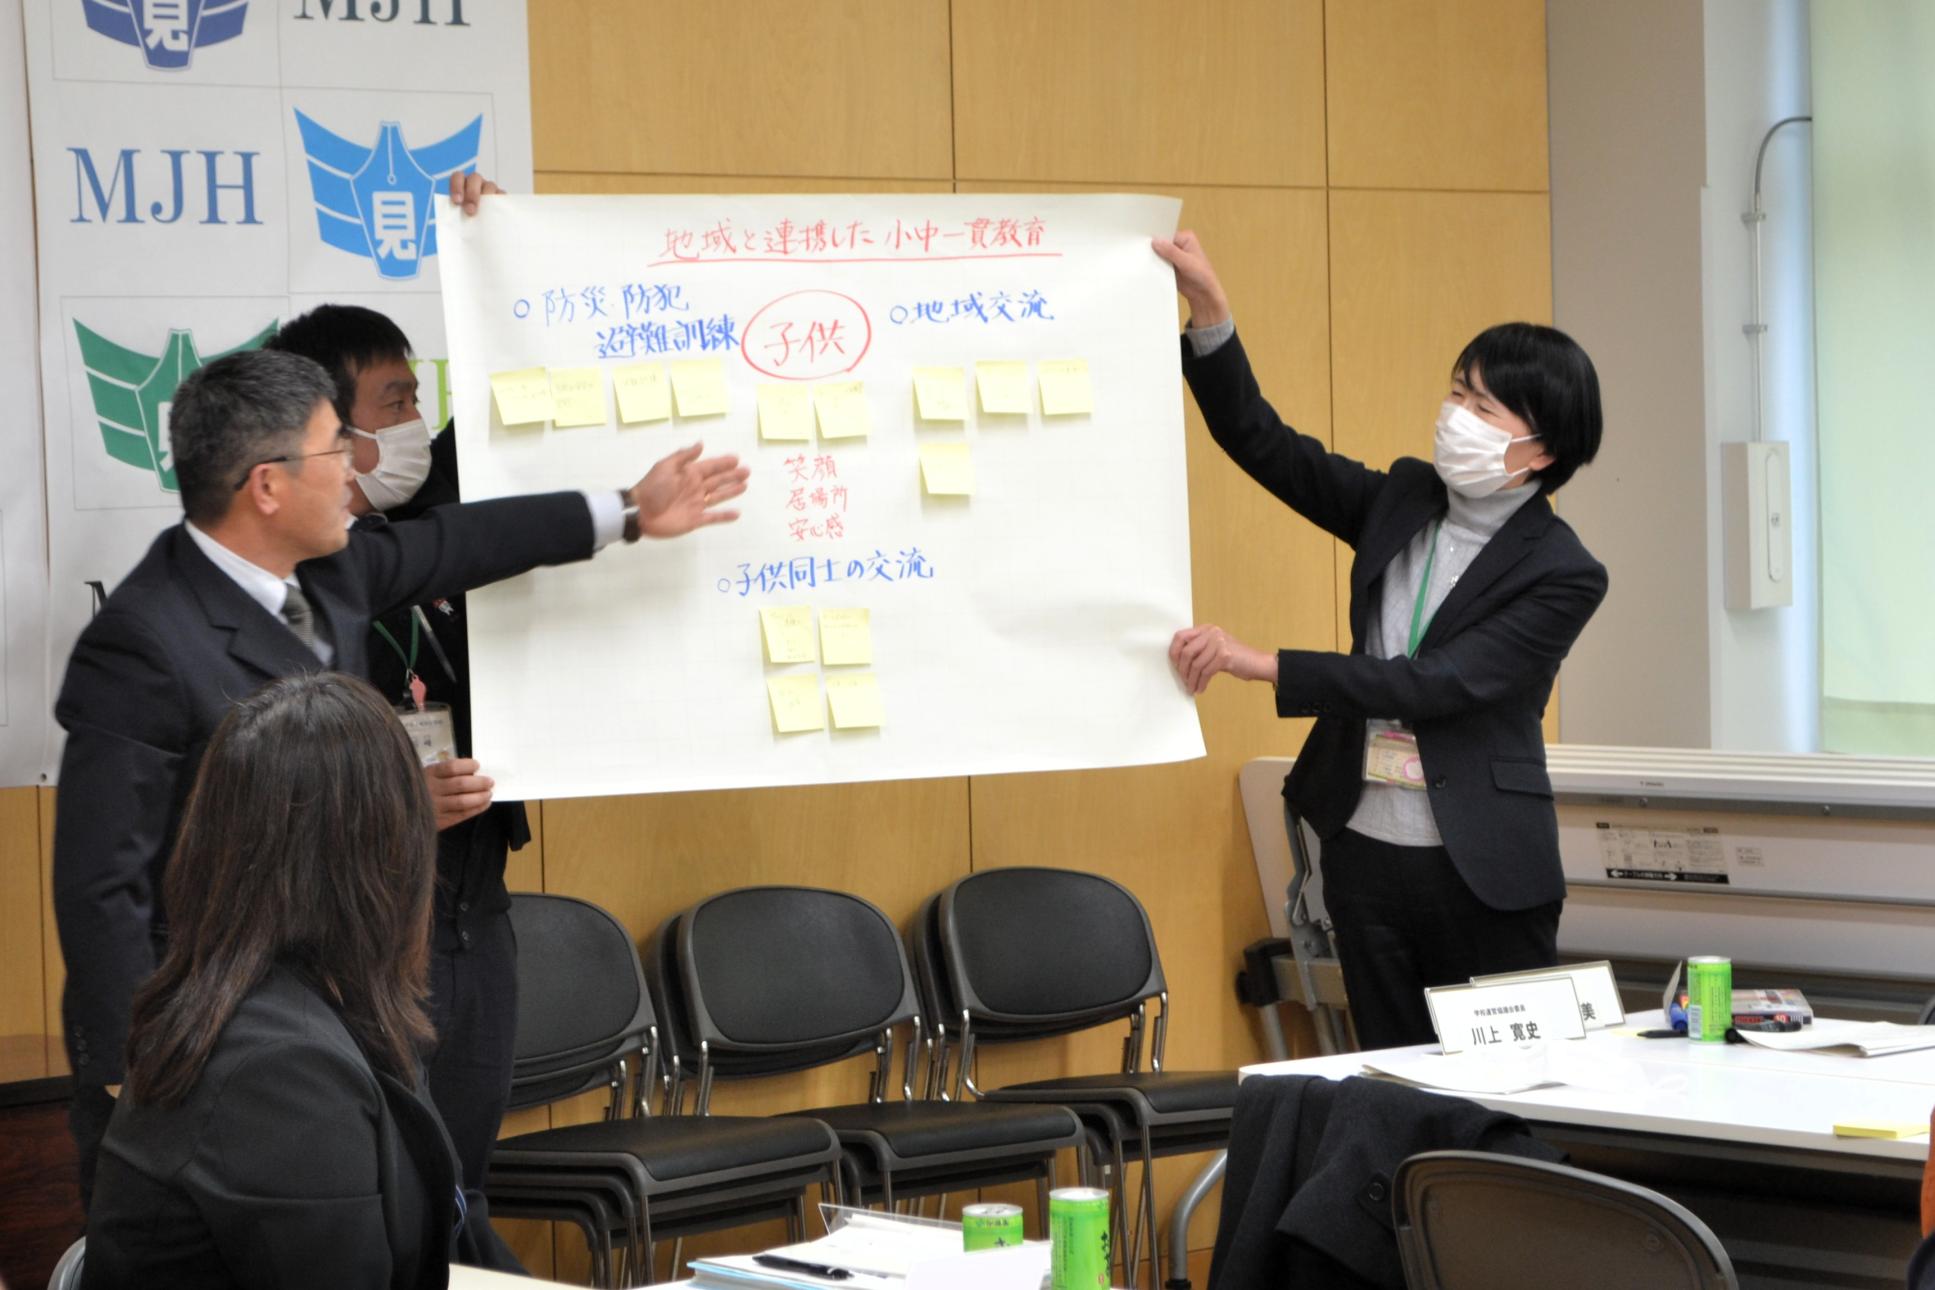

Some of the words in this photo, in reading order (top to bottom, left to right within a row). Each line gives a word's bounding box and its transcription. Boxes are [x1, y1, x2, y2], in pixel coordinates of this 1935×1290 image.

[66, 147, 264, 226] MJH
[372, 191, 417, 261] 見
[597, 314, 740, 359] 避難訓練
[763, 319, 846, 367] 子供
[784, 453, 838, 482] 笑顔
[786, 485, 848, 512] 居場所
[788, 512, 844, 541] 安心感
[1581, 1002, 1597, 1021] 美
[1471, 1026, 1503, 1046] 川上
[1510, 1020, 1542, 1043] 寛史
